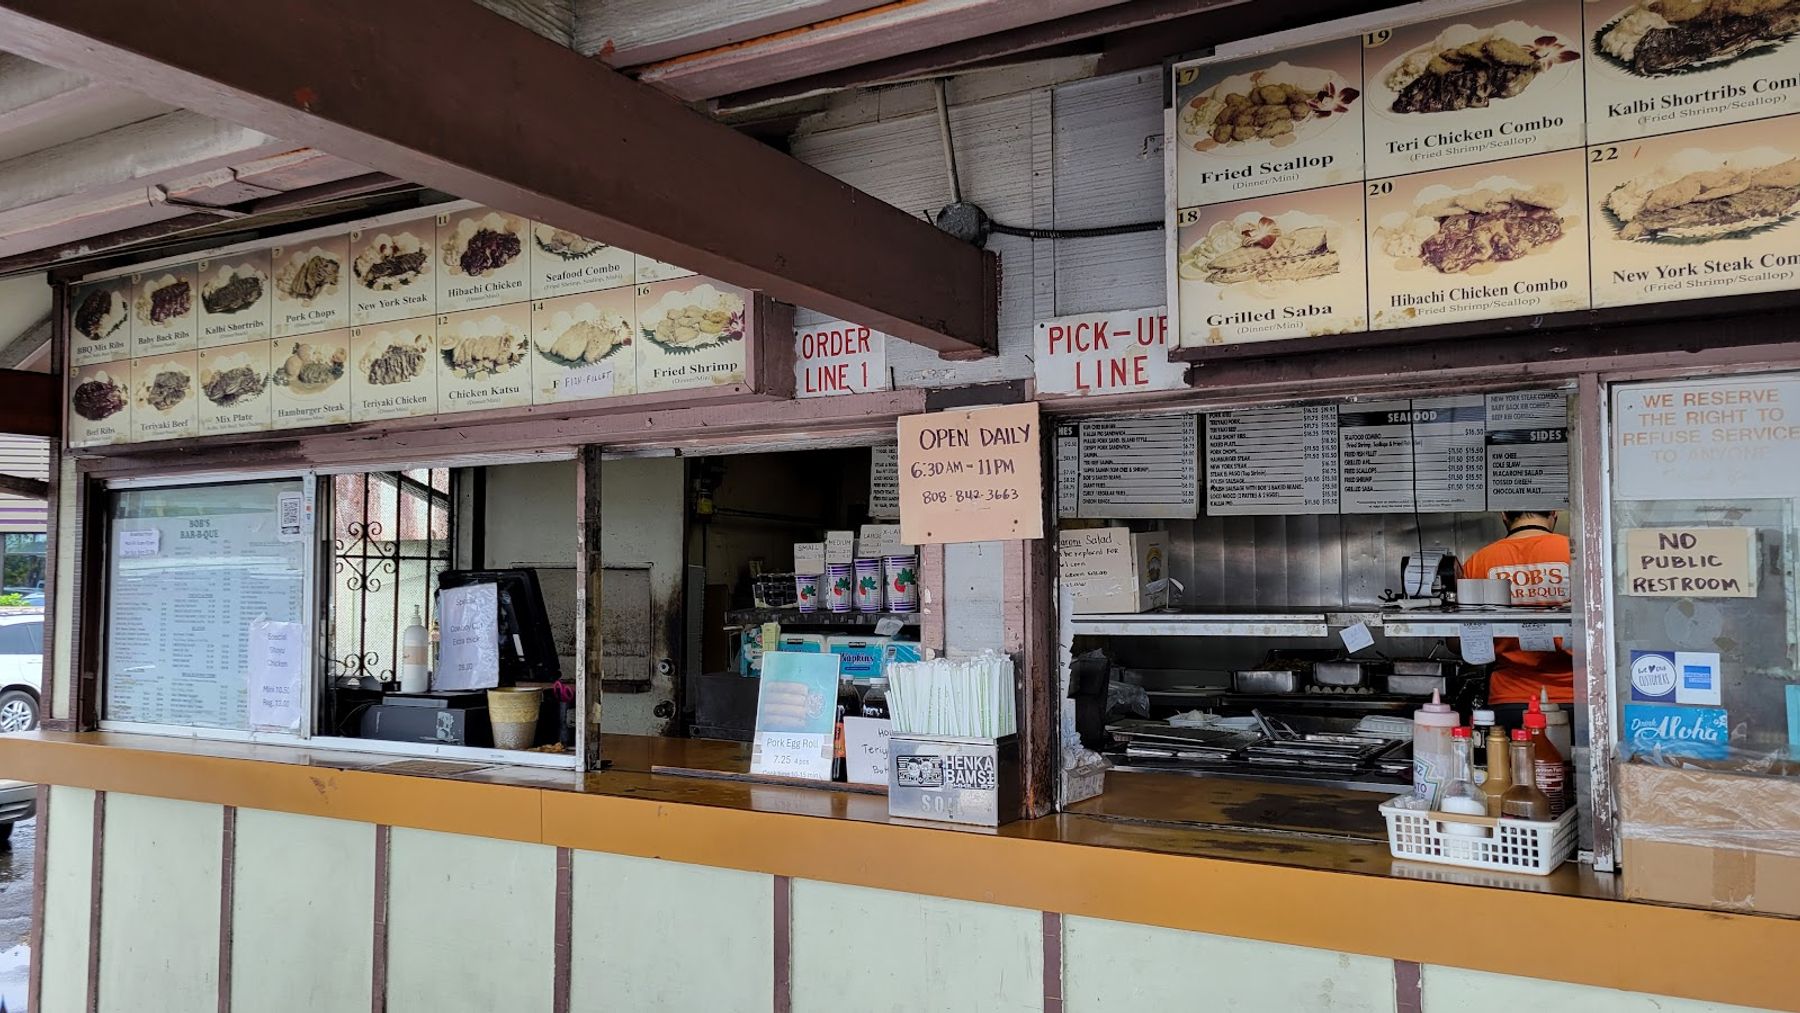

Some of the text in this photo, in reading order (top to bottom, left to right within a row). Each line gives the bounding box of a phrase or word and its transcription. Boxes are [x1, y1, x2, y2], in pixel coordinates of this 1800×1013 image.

[1367, 29, 1390, 44] 19
[1607, 98, 1655, 118] Kalbi
[1660, 84, 1747, 109] Shortribs
[1637, 93, 1788, 126] (Fried Shrimp/Scallop)
[1385, 115, 1564, 154] Teri Chicken Combo
[1409, 134, 1538, 163] (Fried Shrimp/Scallop)
[1590, 147, 1619, 163] 22
[1201, 154, 1334, 184] Fried Scallop
[1232, 173, 1300, 190] (Dinner/Mini)
[1368, 181, 1393, 196] 20
[438, 216, 447, 224] 11
[1178, 210, 1198, 224] 18
[545, 263, 620, 282] Seafood Combo
[1611, 269, 1649, 284] New
[1656, 262, 1699, 279] York
[1703, 256, 1754, 274] Steak
[448, 279, 523, 297] Hibachi Chicken
[1643, 270, 1795, 293] (Fried Shrimp/Scallop)
[636, 286, 650, 296] 16
[1390, 277, 1568, 308] Hibachi Chicken Combo
[357, 293, 428, 311] New York Steak
[532, 303, 543, 311] 14
[1449, 296, 1541, 314] Shrimp/Scallop)
[285, 309, 335, 322] Pork Chops
[438, 316, 448, 325] 12
[1206, 304, 1333, 327] Grilled Saba
[205, 319, 264, 335] Kalbi Shortribs
[351, 329, 361, 337] 10
[1236, 321, 1304, 335] (Dinner/Mini)
[139, 331, 190, 345] Baby Back Ribs
[802, 327, 871, 360] ORDER
[77, 341, 124, 354] BBQ Mix Ribs
[653, 361, 738, 378] Fried Shrimp
[806, 361, 867, 393] LINE 1
[1076, 355, 1149, 390] LINE
[448, 386, 520, 400] Chicken Katsu
[1642, 388, 1780, 409] WE RESERVE
[277, 403, 344, 417] Hamburger Steak
[363, 395, 427, 409] Teriyaki Chicken
[140, 419, 188, 431] Teriyaki Beef
[215, 413, 253, 423] Mix Plate
[1638, 407, 1784, 427] THE RIGHT TO
[86, 428, 100, 436] Beef
[919, 423, 1030, 451] OPEN DAILY
[1529, 429, 1562, 442] SIDES
[1622, 425, 1800, 447] REFUSE SERVICE
[1654, 449, 1677, 464] TO
[188, 519, 211, 528] BOB'S
[828, 538, 852, 546] MEDIUM
[1085, 532, 1113, 545] Salad
[1658, 532, 1697, 551] NO
[1640, 554, 1723, 570] PUBLIC
[1633, 576, 1741, 594] RESTROOM
[1635, 715, 1718, 741] Aloha
[766, 737, 819, 750] Pork Egg Roll
[773, 754, 791, 764] 7.25
[945, 755, 993, 770] HENKA
